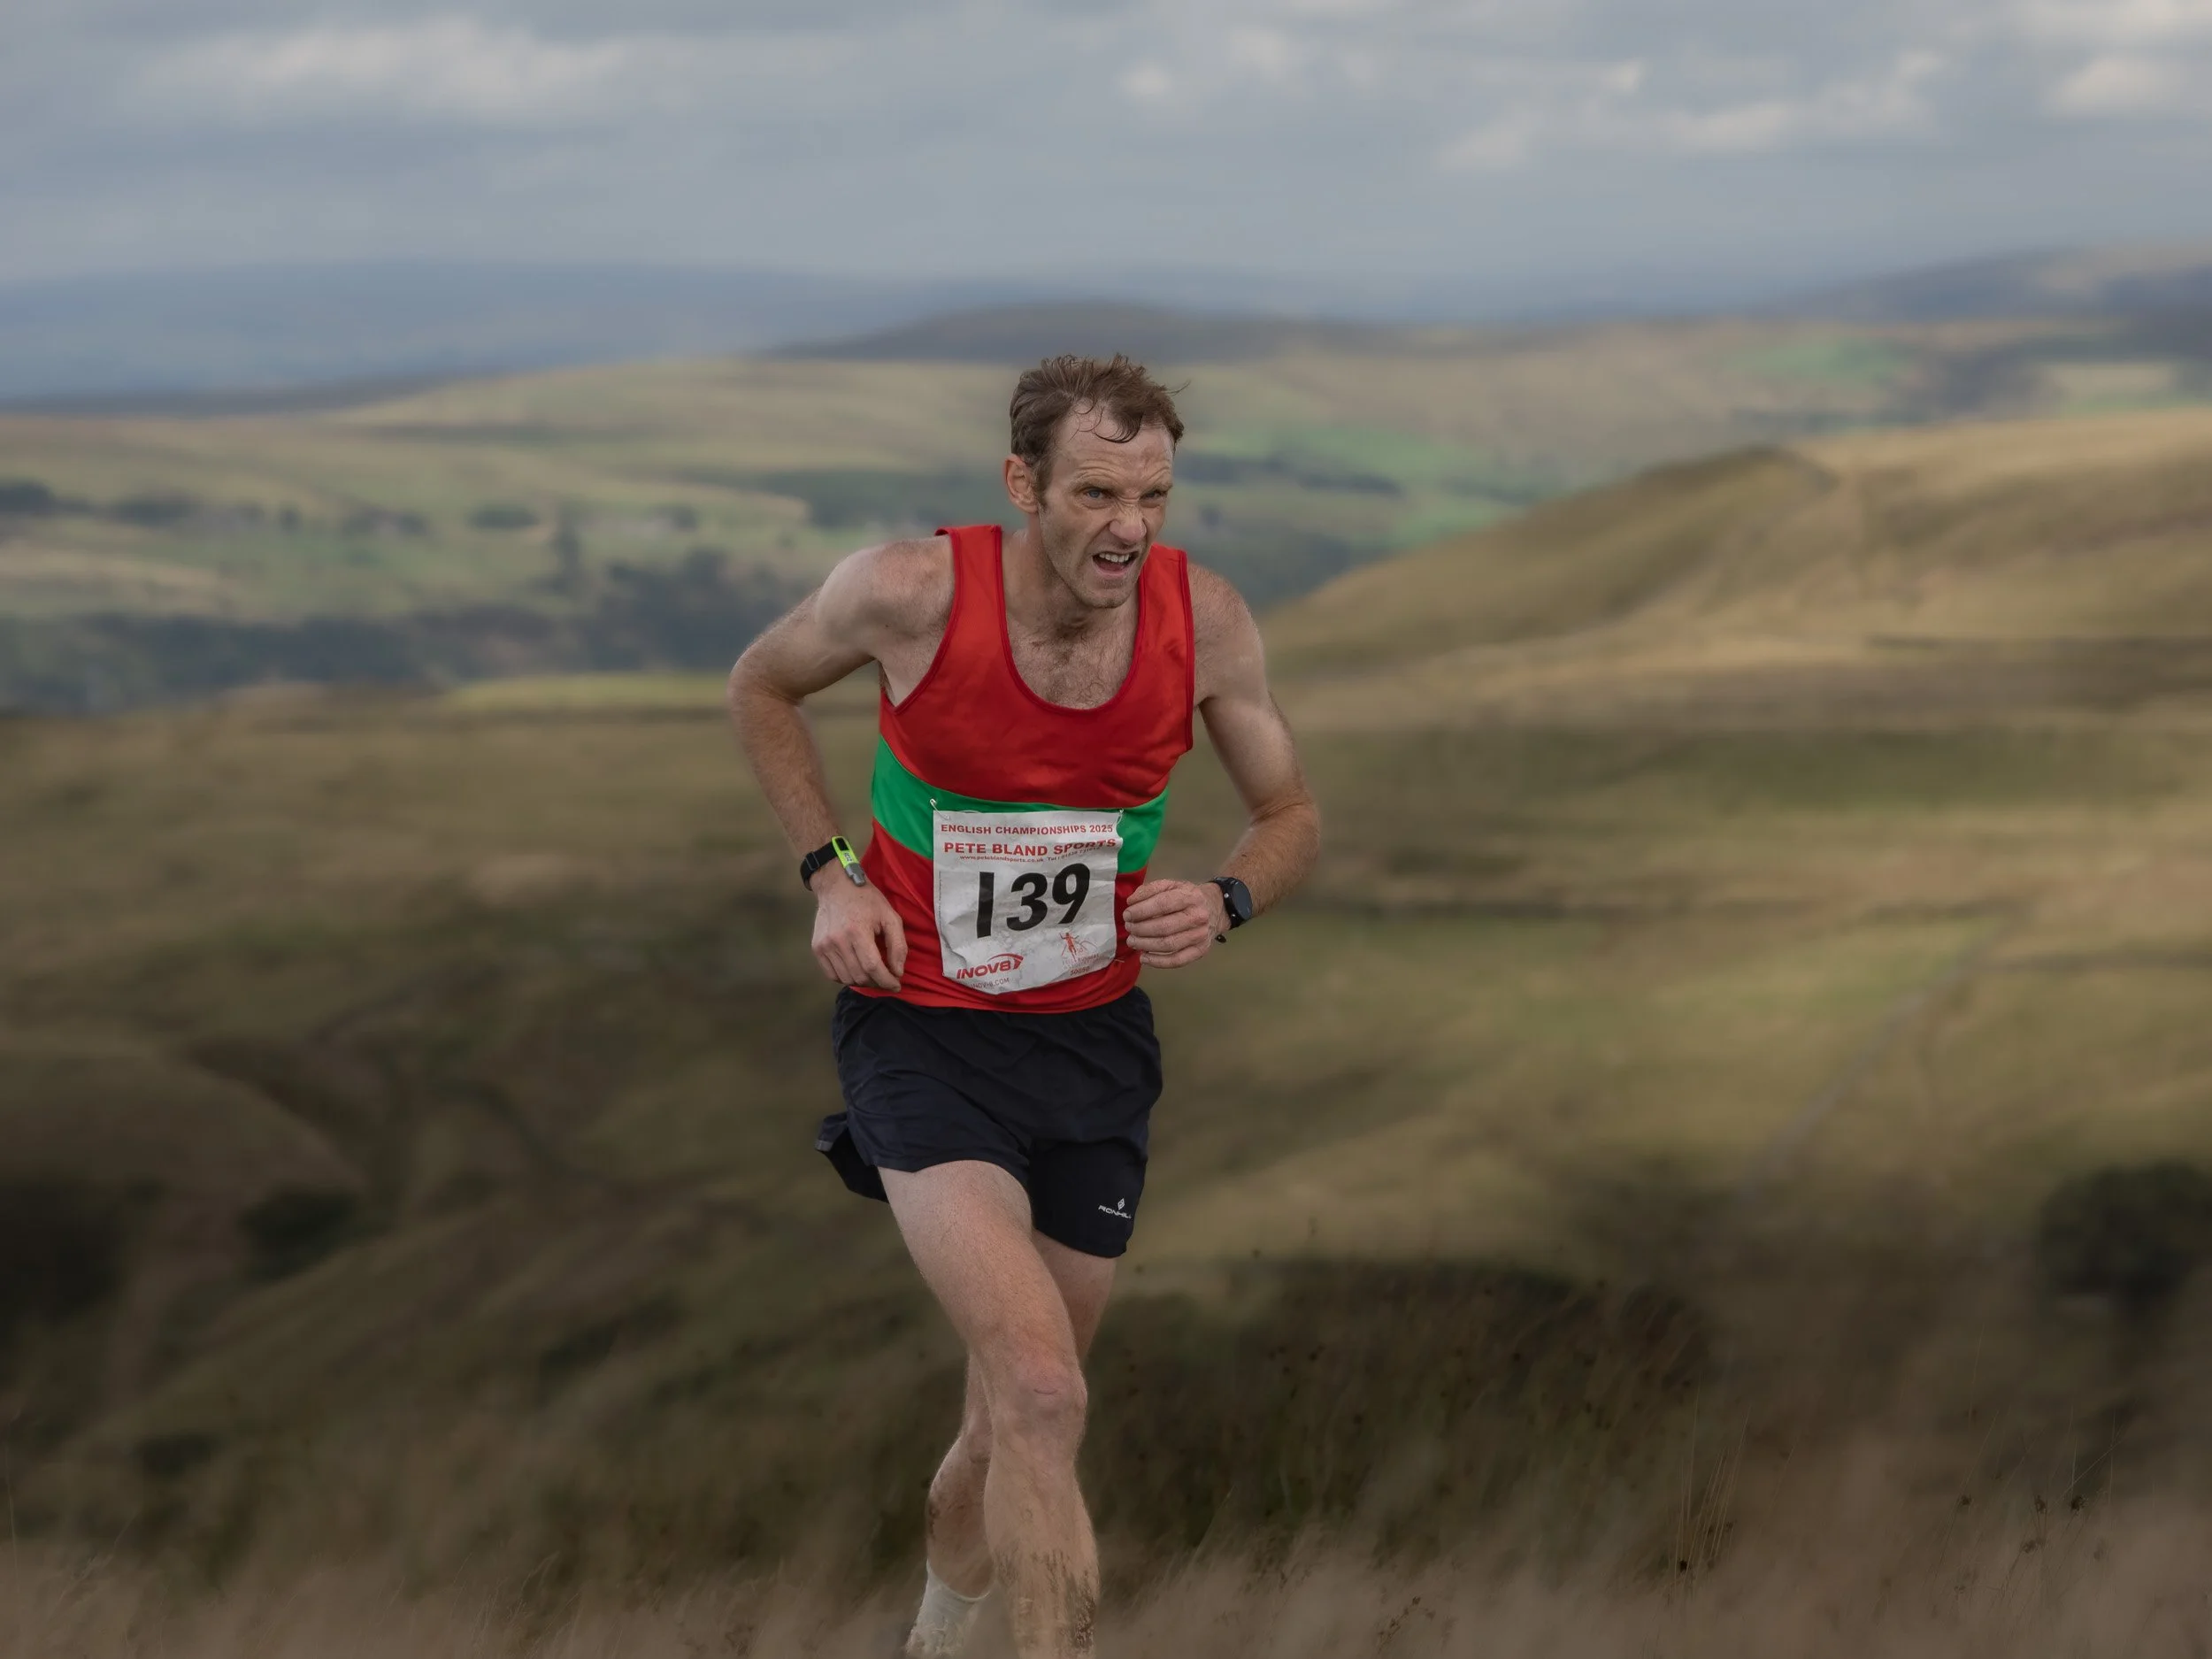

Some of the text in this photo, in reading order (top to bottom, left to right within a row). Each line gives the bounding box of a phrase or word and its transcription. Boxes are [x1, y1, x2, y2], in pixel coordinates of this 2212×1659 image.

[941, 824, 1113, 835] ENGLISH CHAMPIONSHIPS 2025
[944, 841, 987, 854] PETE
[992, 843, 1048, 856] BLAND
[1053, 838, 1117, 855] SPORTS
[960, 855, 1044, 864] www.peteblandsports.co.uk
[977, 863, 1090, 939] 139
[956, 960, 1011, 979] INOV8
[1097, 1204, 1133, 1219] RONHILL
